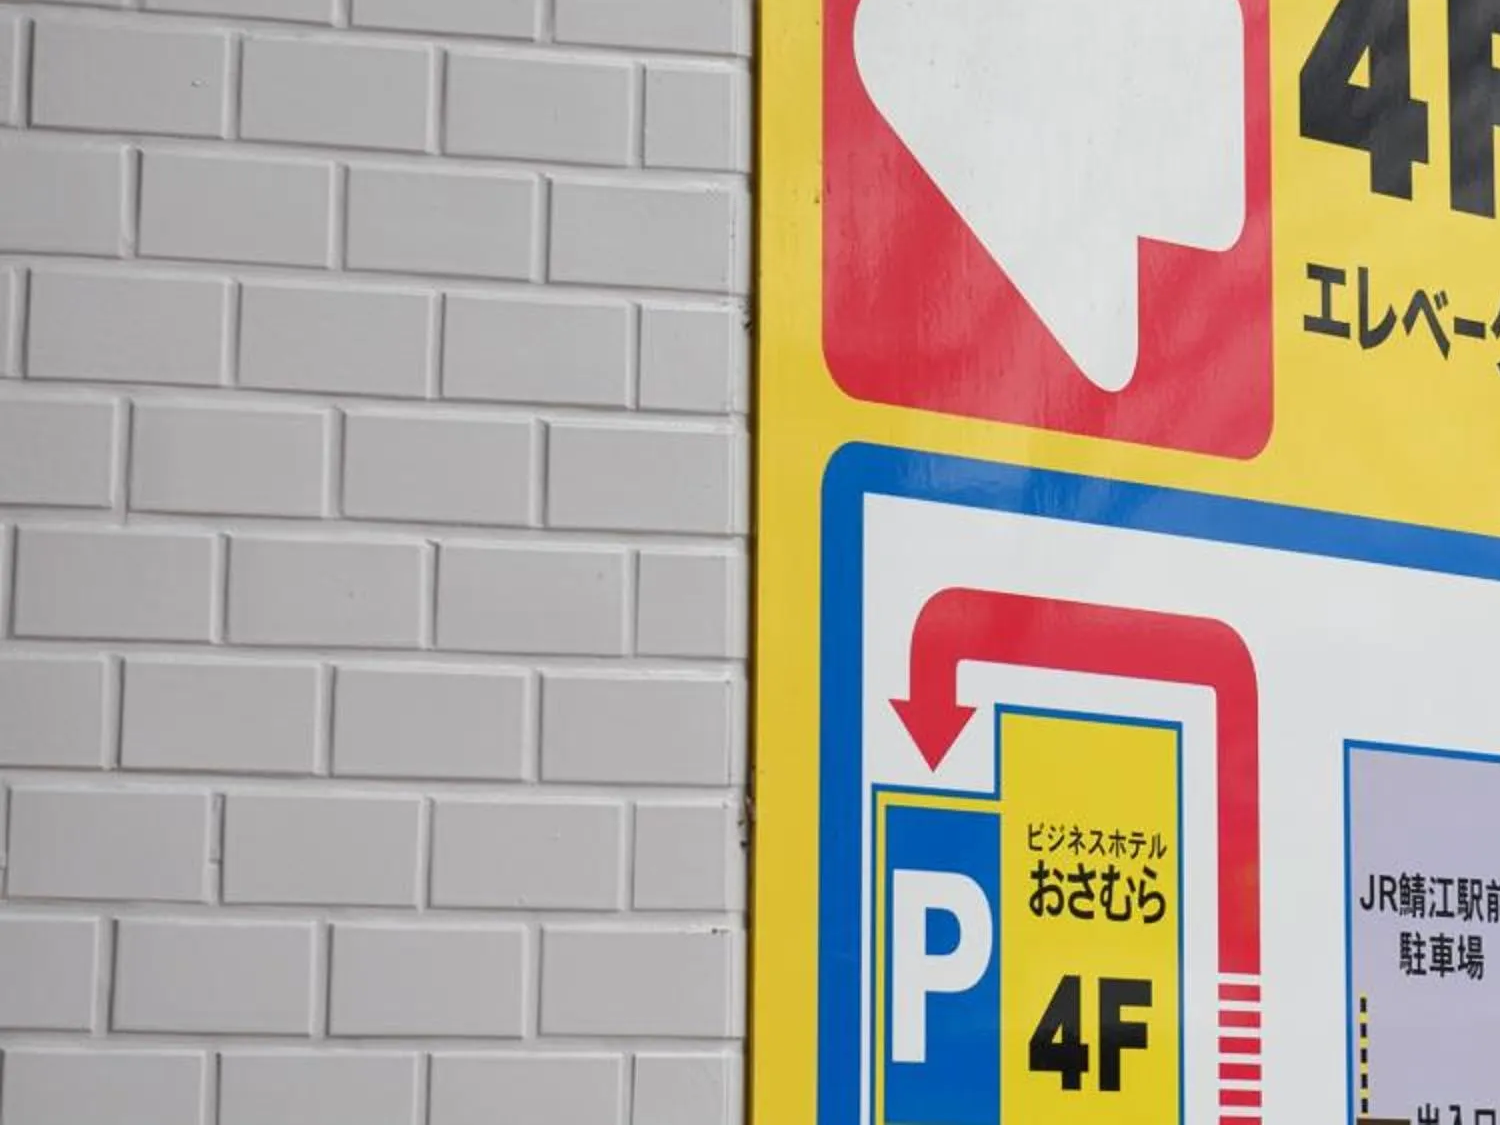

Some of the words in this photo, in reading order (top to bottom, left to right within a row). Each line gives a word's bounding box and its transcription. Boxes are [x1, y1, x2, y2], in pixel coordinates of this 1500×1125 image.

[1026, 822, 1168, 861] ビジネスホテル
[1028, 859, 1167, 925] おさむら
[891, 868, 993, 1064] P
[1399, 931, 1485, 981] 駐車場
[1028, 974, 1153, 1092] 4F
